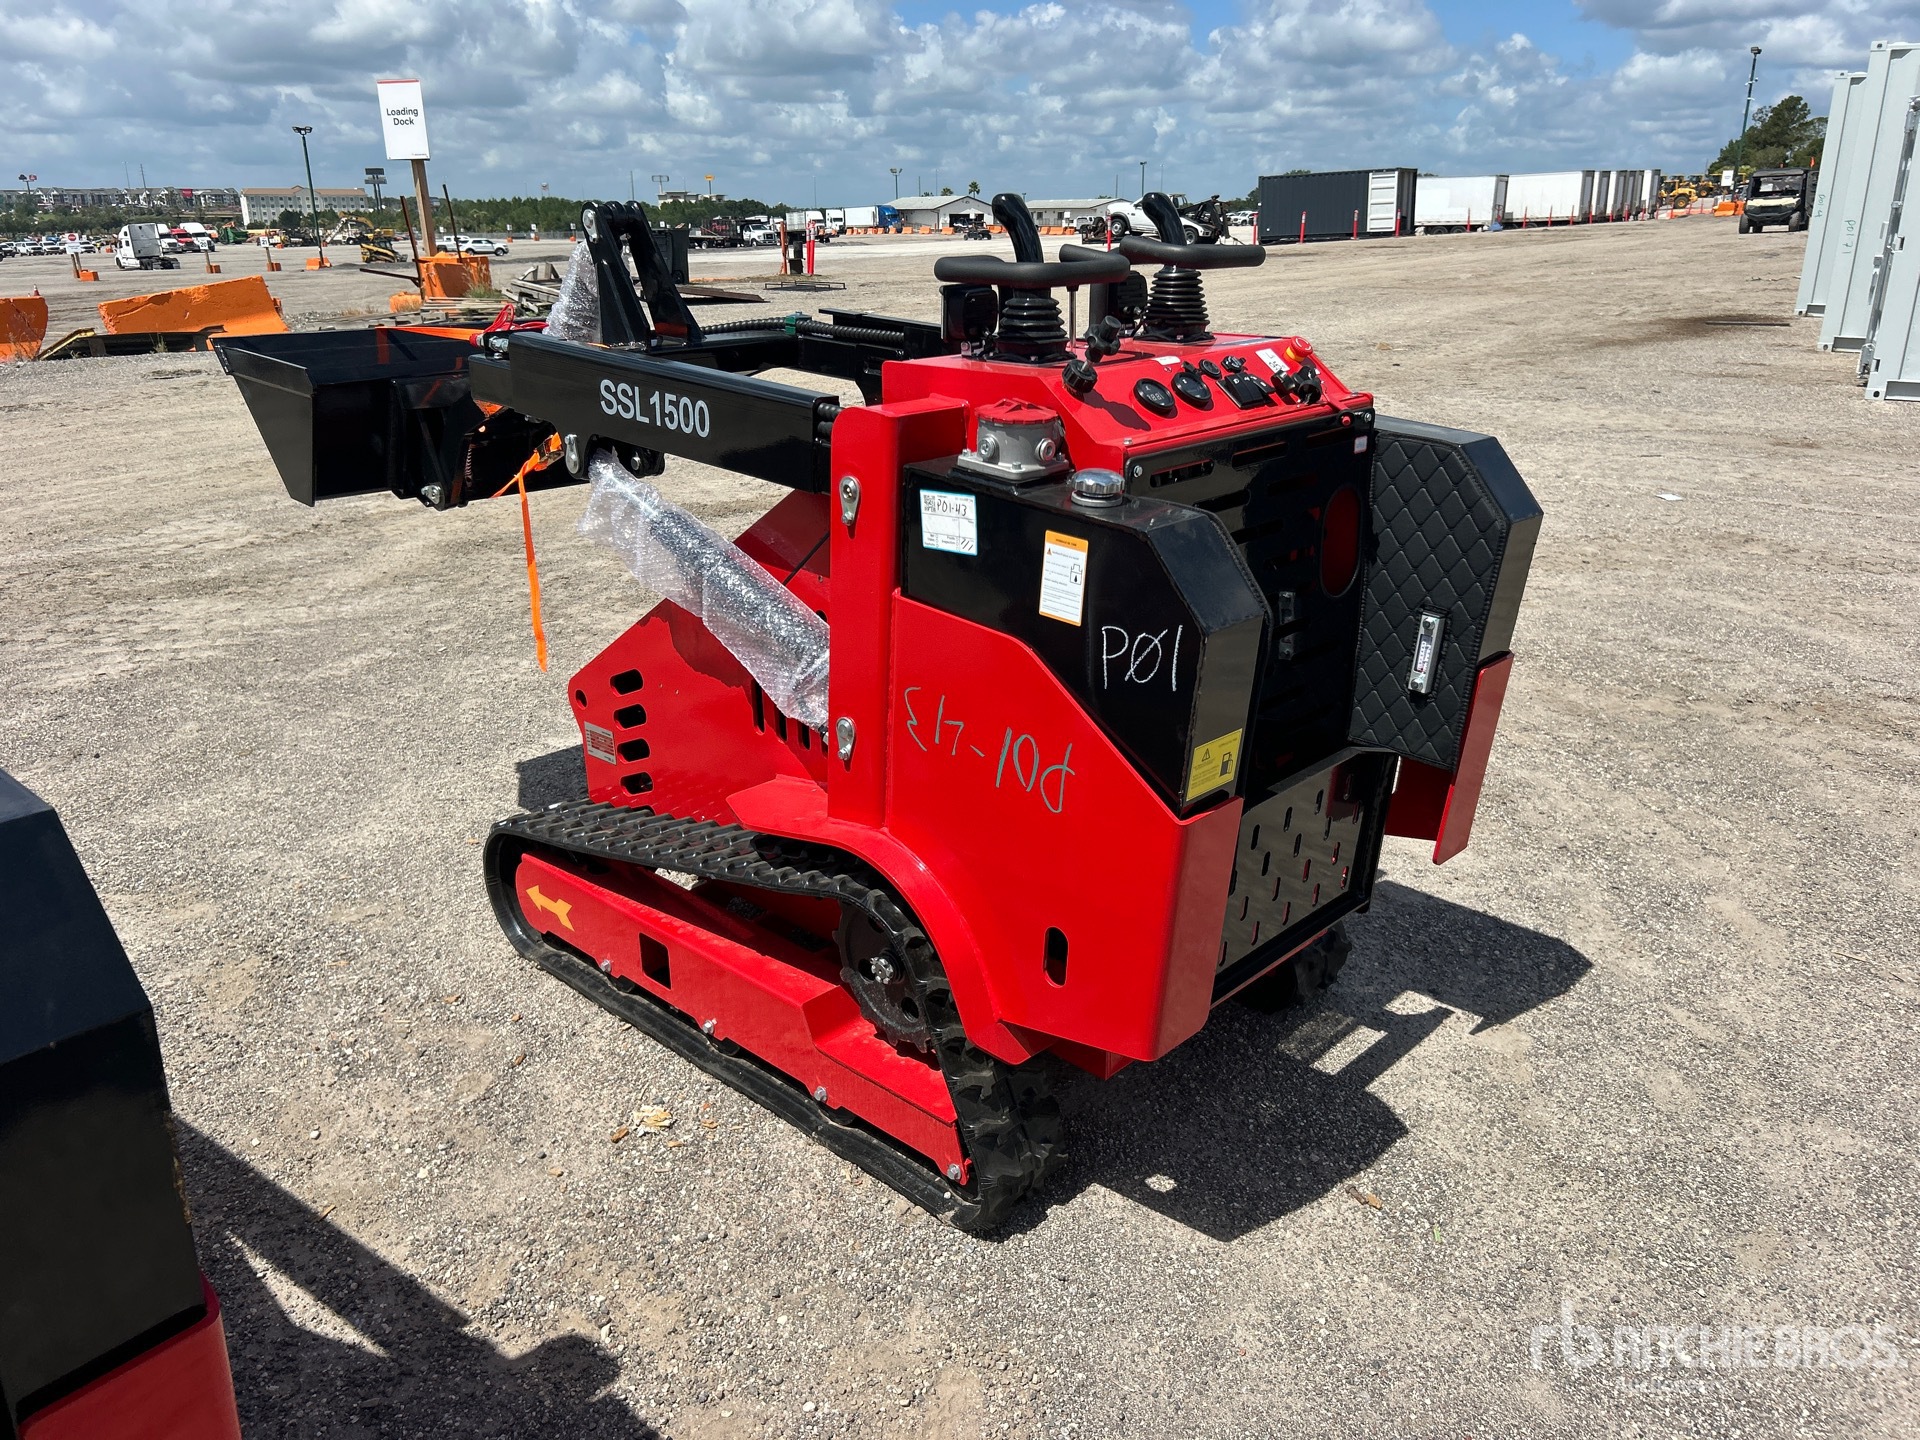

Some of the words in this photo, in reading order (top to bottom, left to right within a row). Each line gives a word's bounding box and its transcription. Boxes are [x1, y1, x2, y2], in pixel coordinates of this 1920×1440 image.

[386, 107, 418, 117] Loading
[393, 117, 414, 125] Dock
[600, 379, 710, 438] SSL1500
